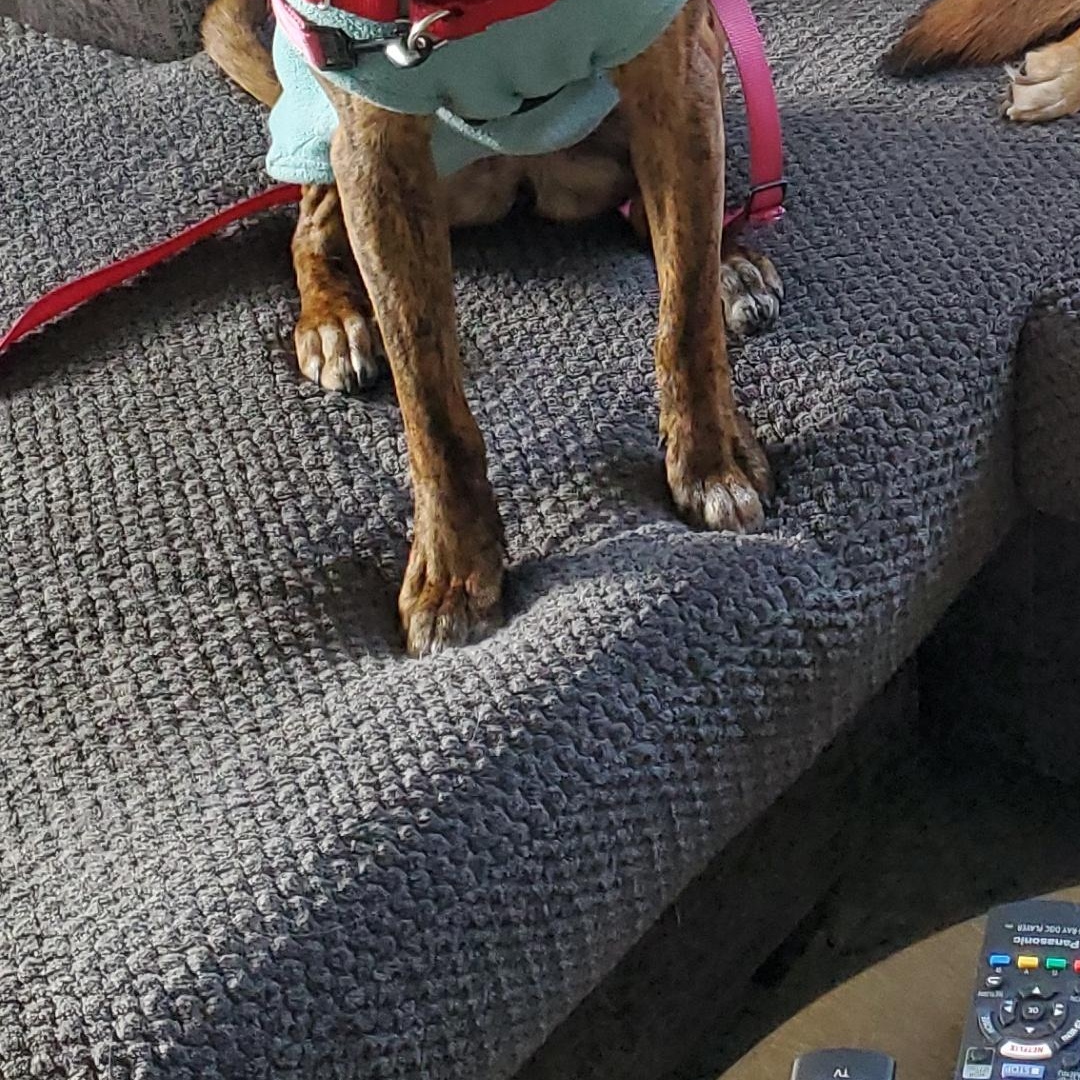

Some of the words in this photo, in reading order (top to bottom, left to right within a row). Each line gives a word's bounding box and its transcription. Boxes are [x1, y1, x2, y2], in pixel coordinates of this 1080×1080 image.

[1017, 923, 1043, 933] PLAYER
[1013, 936, 1080, 950] Panasonic
[1028, 1006, 1039, 1014] OK
[1010, 1045, 1044, 1053] NETFLIX
[833, 1067, 850, 1078] TV
